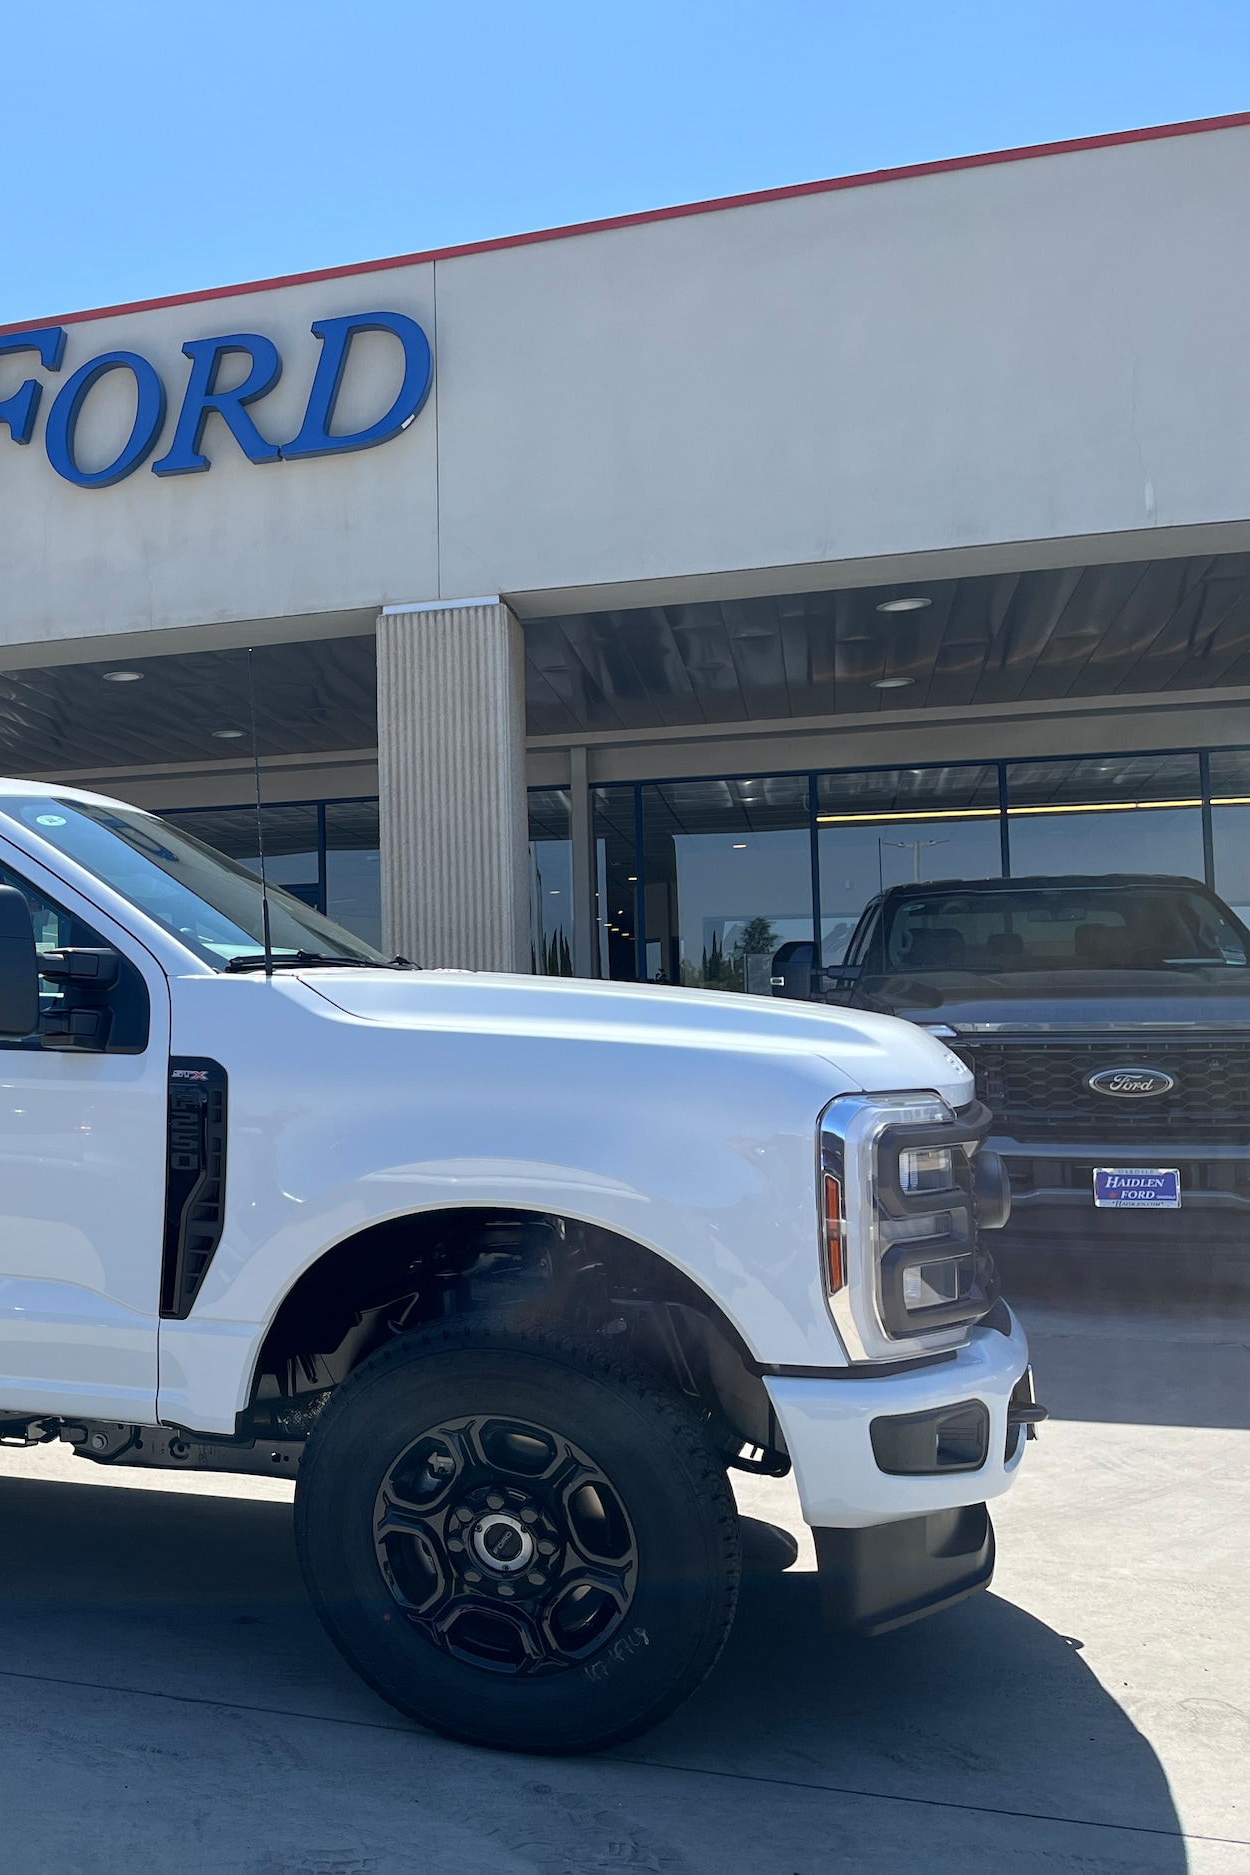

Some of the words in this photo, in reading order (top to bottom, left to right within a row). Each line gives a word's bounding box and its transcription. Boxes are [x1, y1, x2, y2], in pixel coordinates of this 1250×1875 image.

[1110, 1073, 1154, 1091] Ford
[1105, 1176, 1165, 1189] HAIDLEN
[1121, 1190, 1156, 1200] FORD
[493, 1530, 513, 1555] FORD
